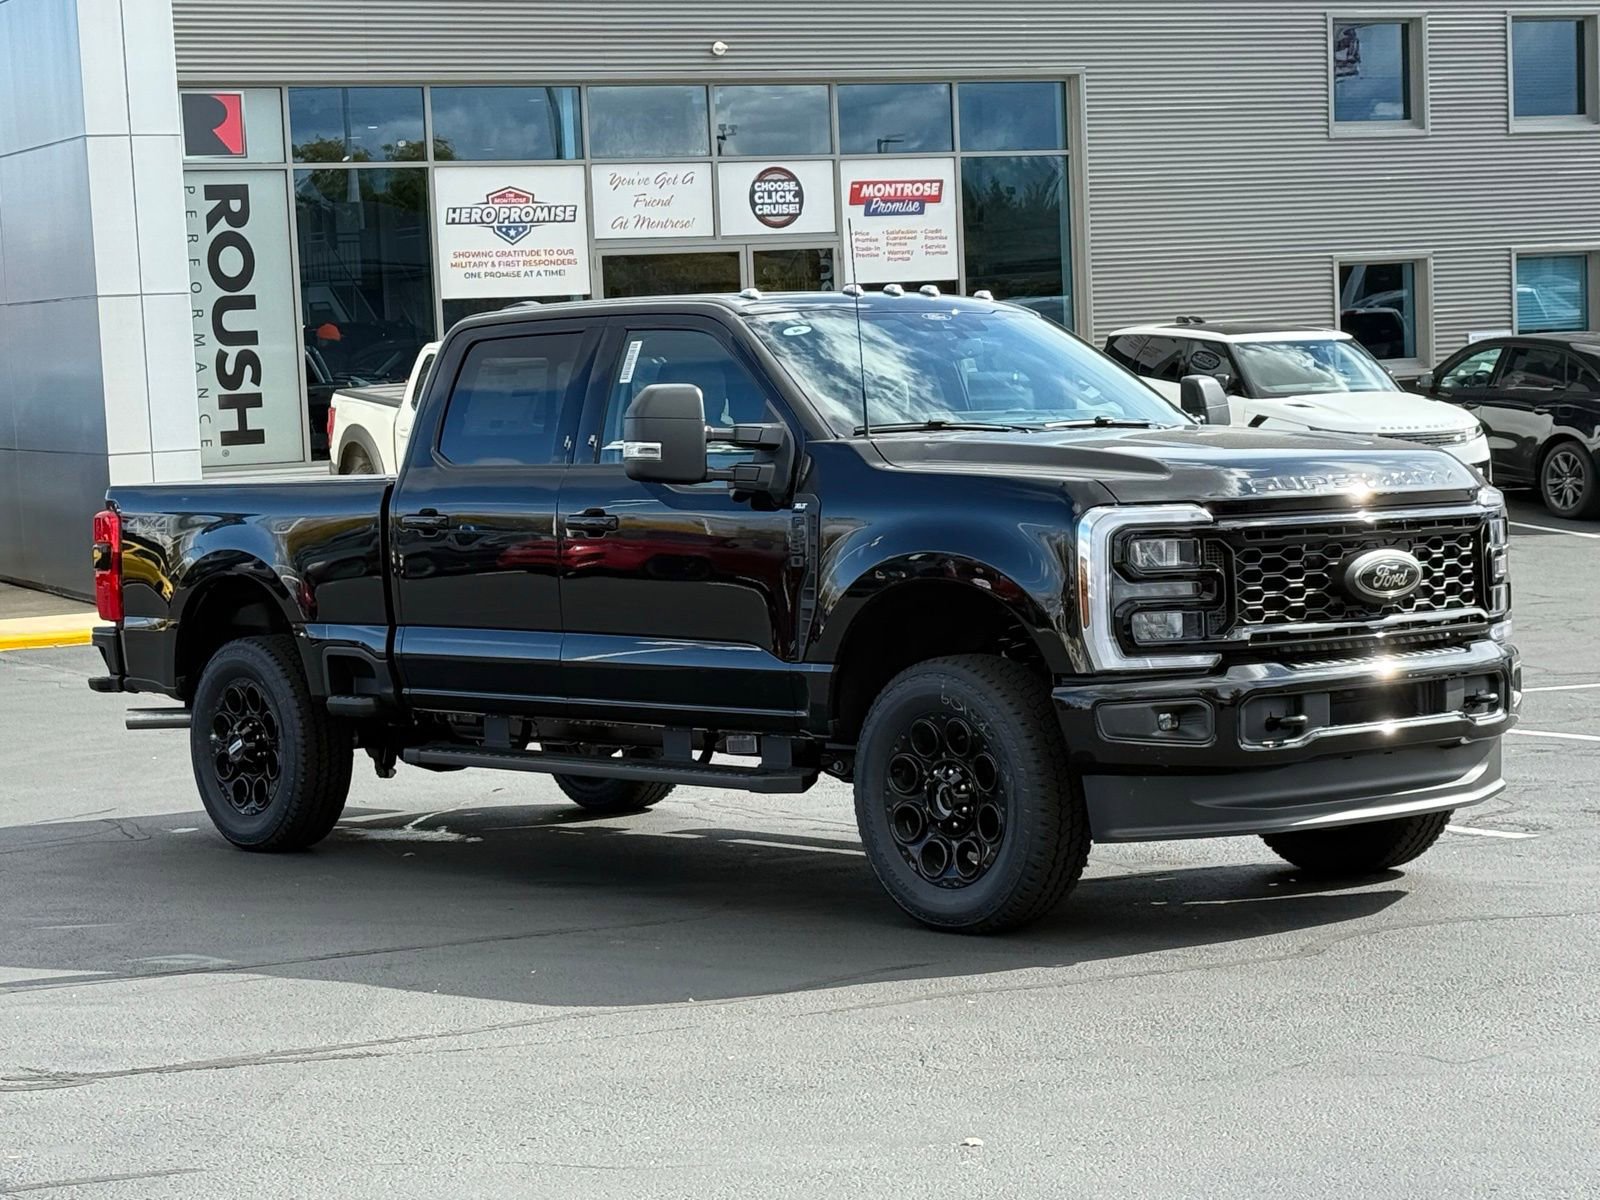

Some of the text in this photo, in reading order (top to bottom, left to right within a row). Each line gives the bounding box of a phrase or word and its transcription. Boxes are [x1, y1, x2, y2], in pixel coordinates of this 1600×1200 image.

[653, 171, 678, 191] Got
[682, 171, 695, 185] A
[754, 181, 799, 191] CHOOSE.
[754, 191, 799, 203] CLICK.
[860, 182, 940, 197] MONTROSE
[632, 193, 674, 208] Friend
[870, 198, 920, 213] Promise
[446, 205, 577, 225] HERO PROMISE
[755, 204, 800, 215] CRUISE!
[611, 214, 696, 230] At Montrose!
[495, 250, 542, 258] GRATITUDE
[543, 249, 554, 257] TO
[522, 259, 577, 267] RESPONDERS
[464, 271, 482, 279] ONE
[484, 270, 521, 278] PROMISE
[544, 269, 566, 277] TIME!
[184, 185, 213, 448] PERFORMANCE
[203, 183, 265, 447] ROUSH
[1372, 564, 1408, 589] Ford
